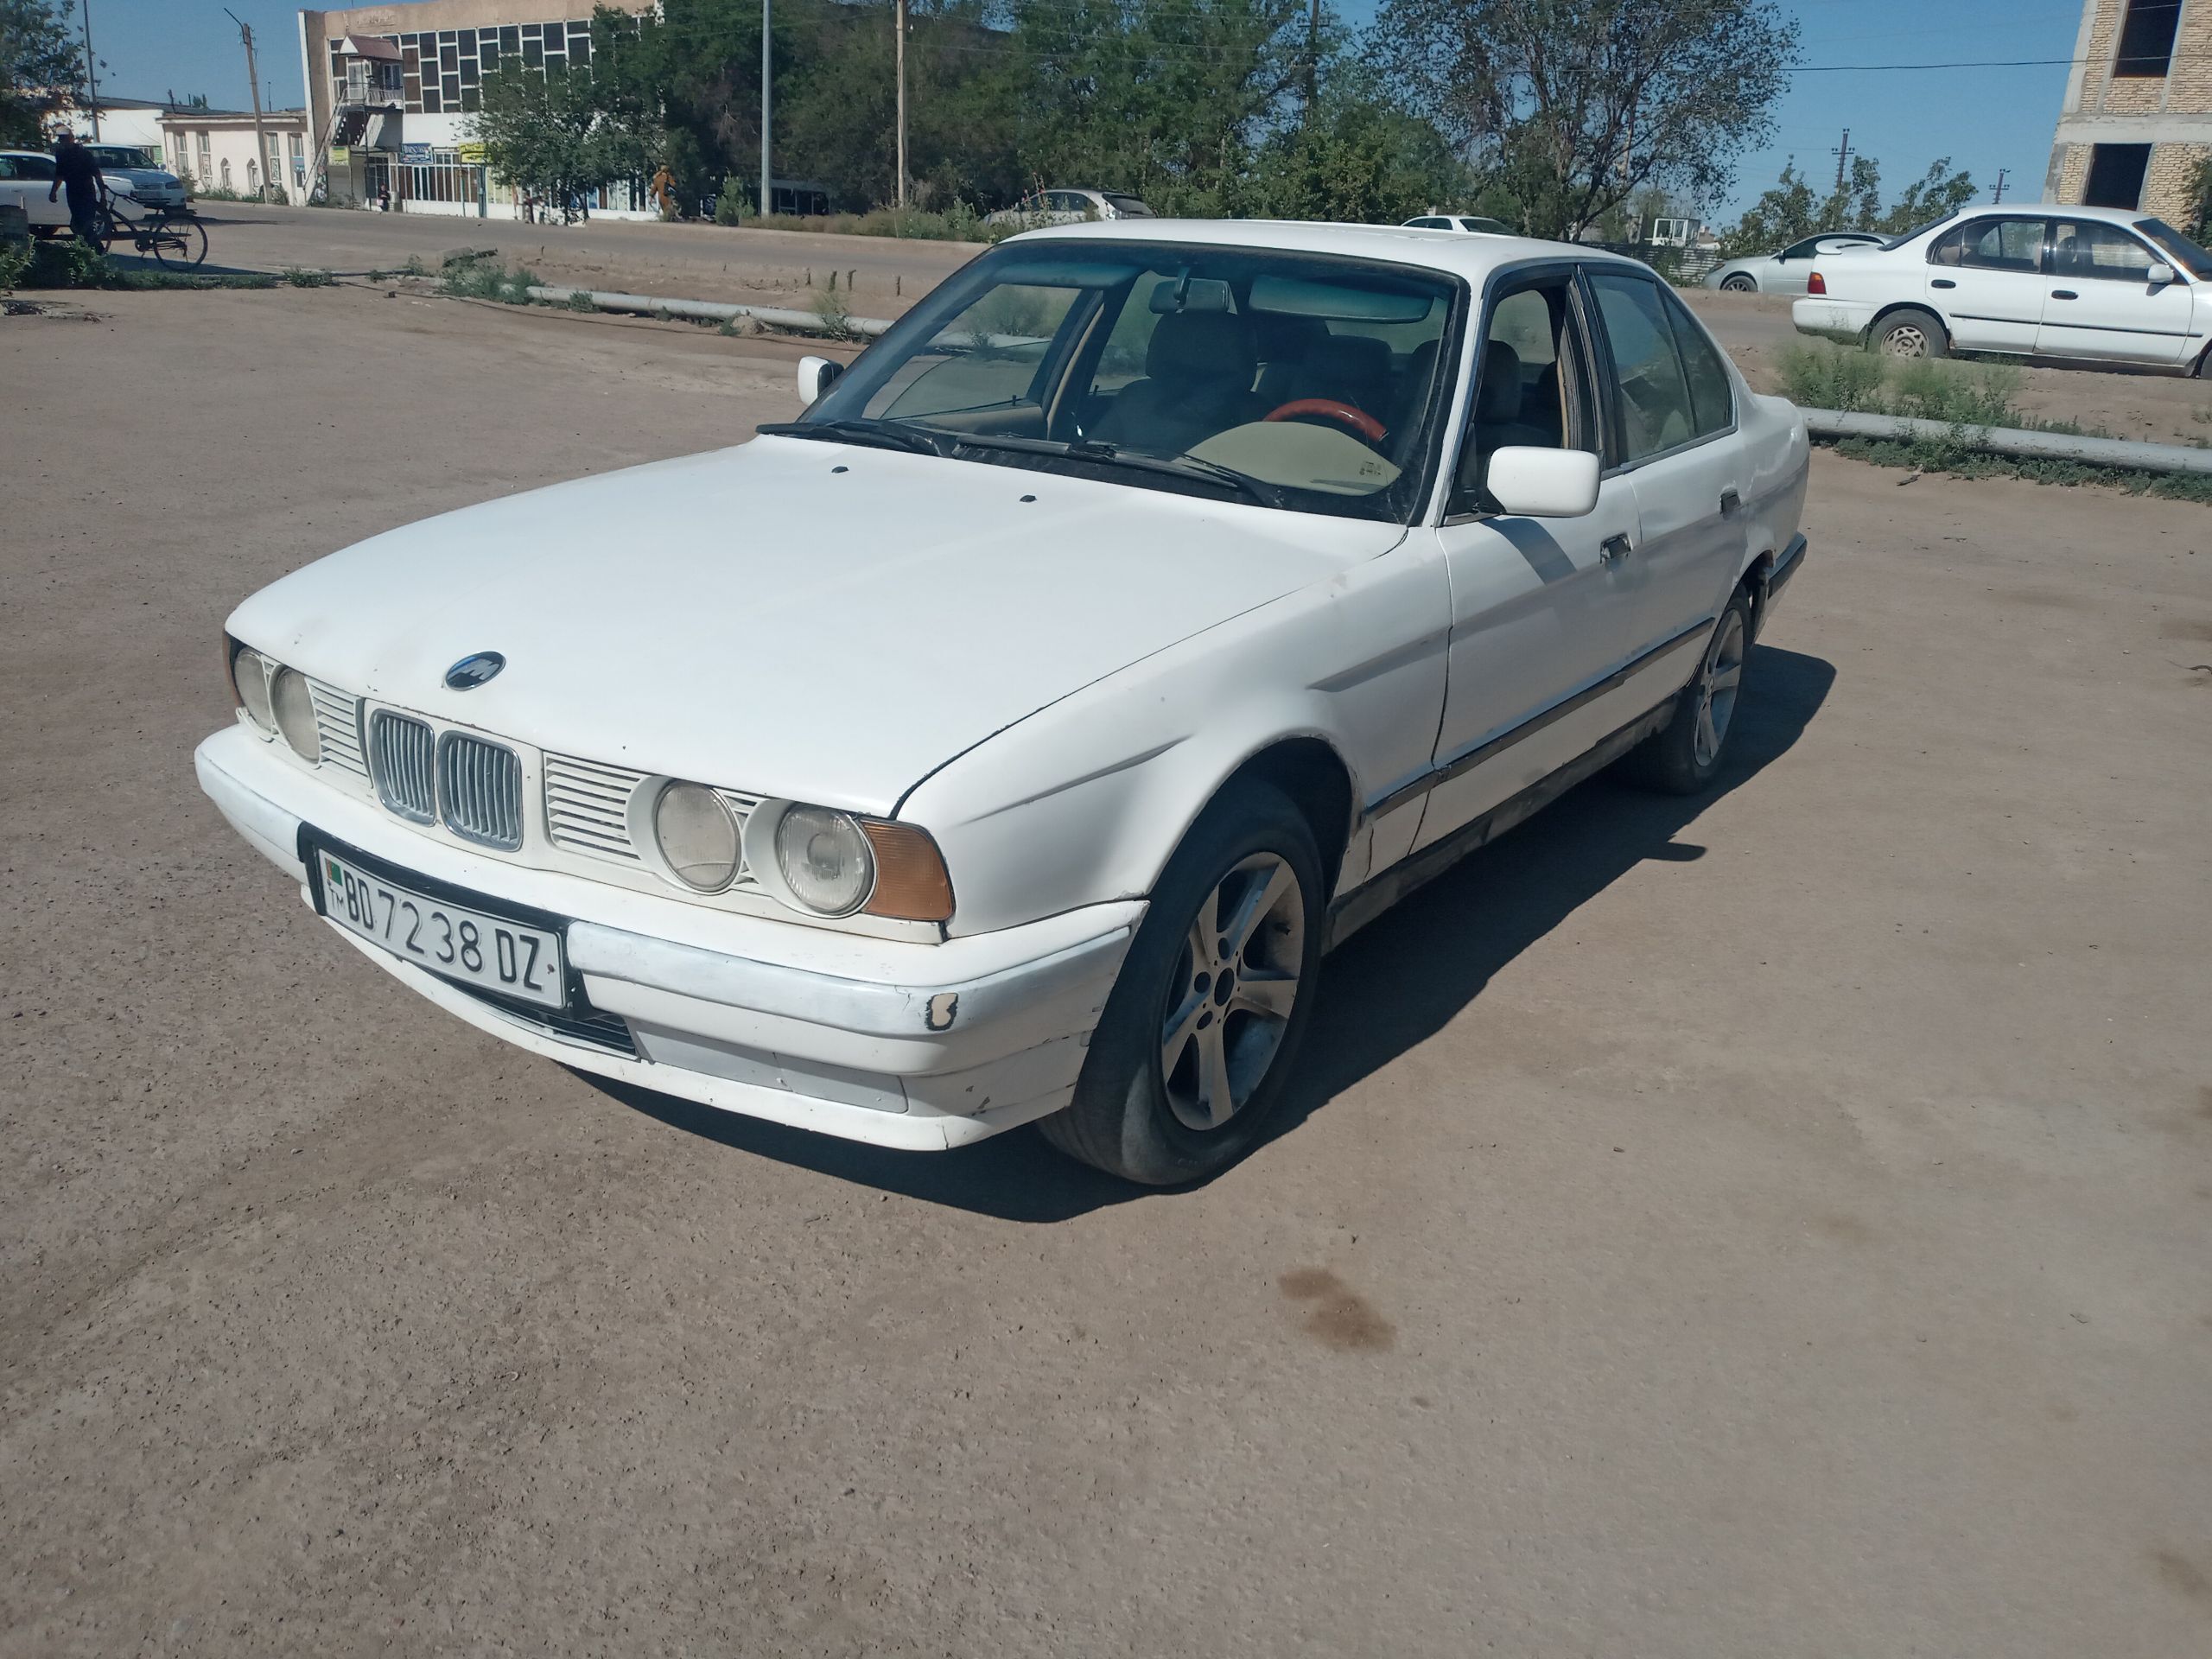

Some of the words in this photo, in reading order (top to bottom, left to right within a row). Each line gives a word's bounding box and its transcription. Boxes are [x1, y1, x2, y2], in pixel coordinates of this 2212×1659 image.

[329, 887, 344, 912] TM
[378, 888, 483, 972] 7238
[495, 928, 543, 991] DZ
